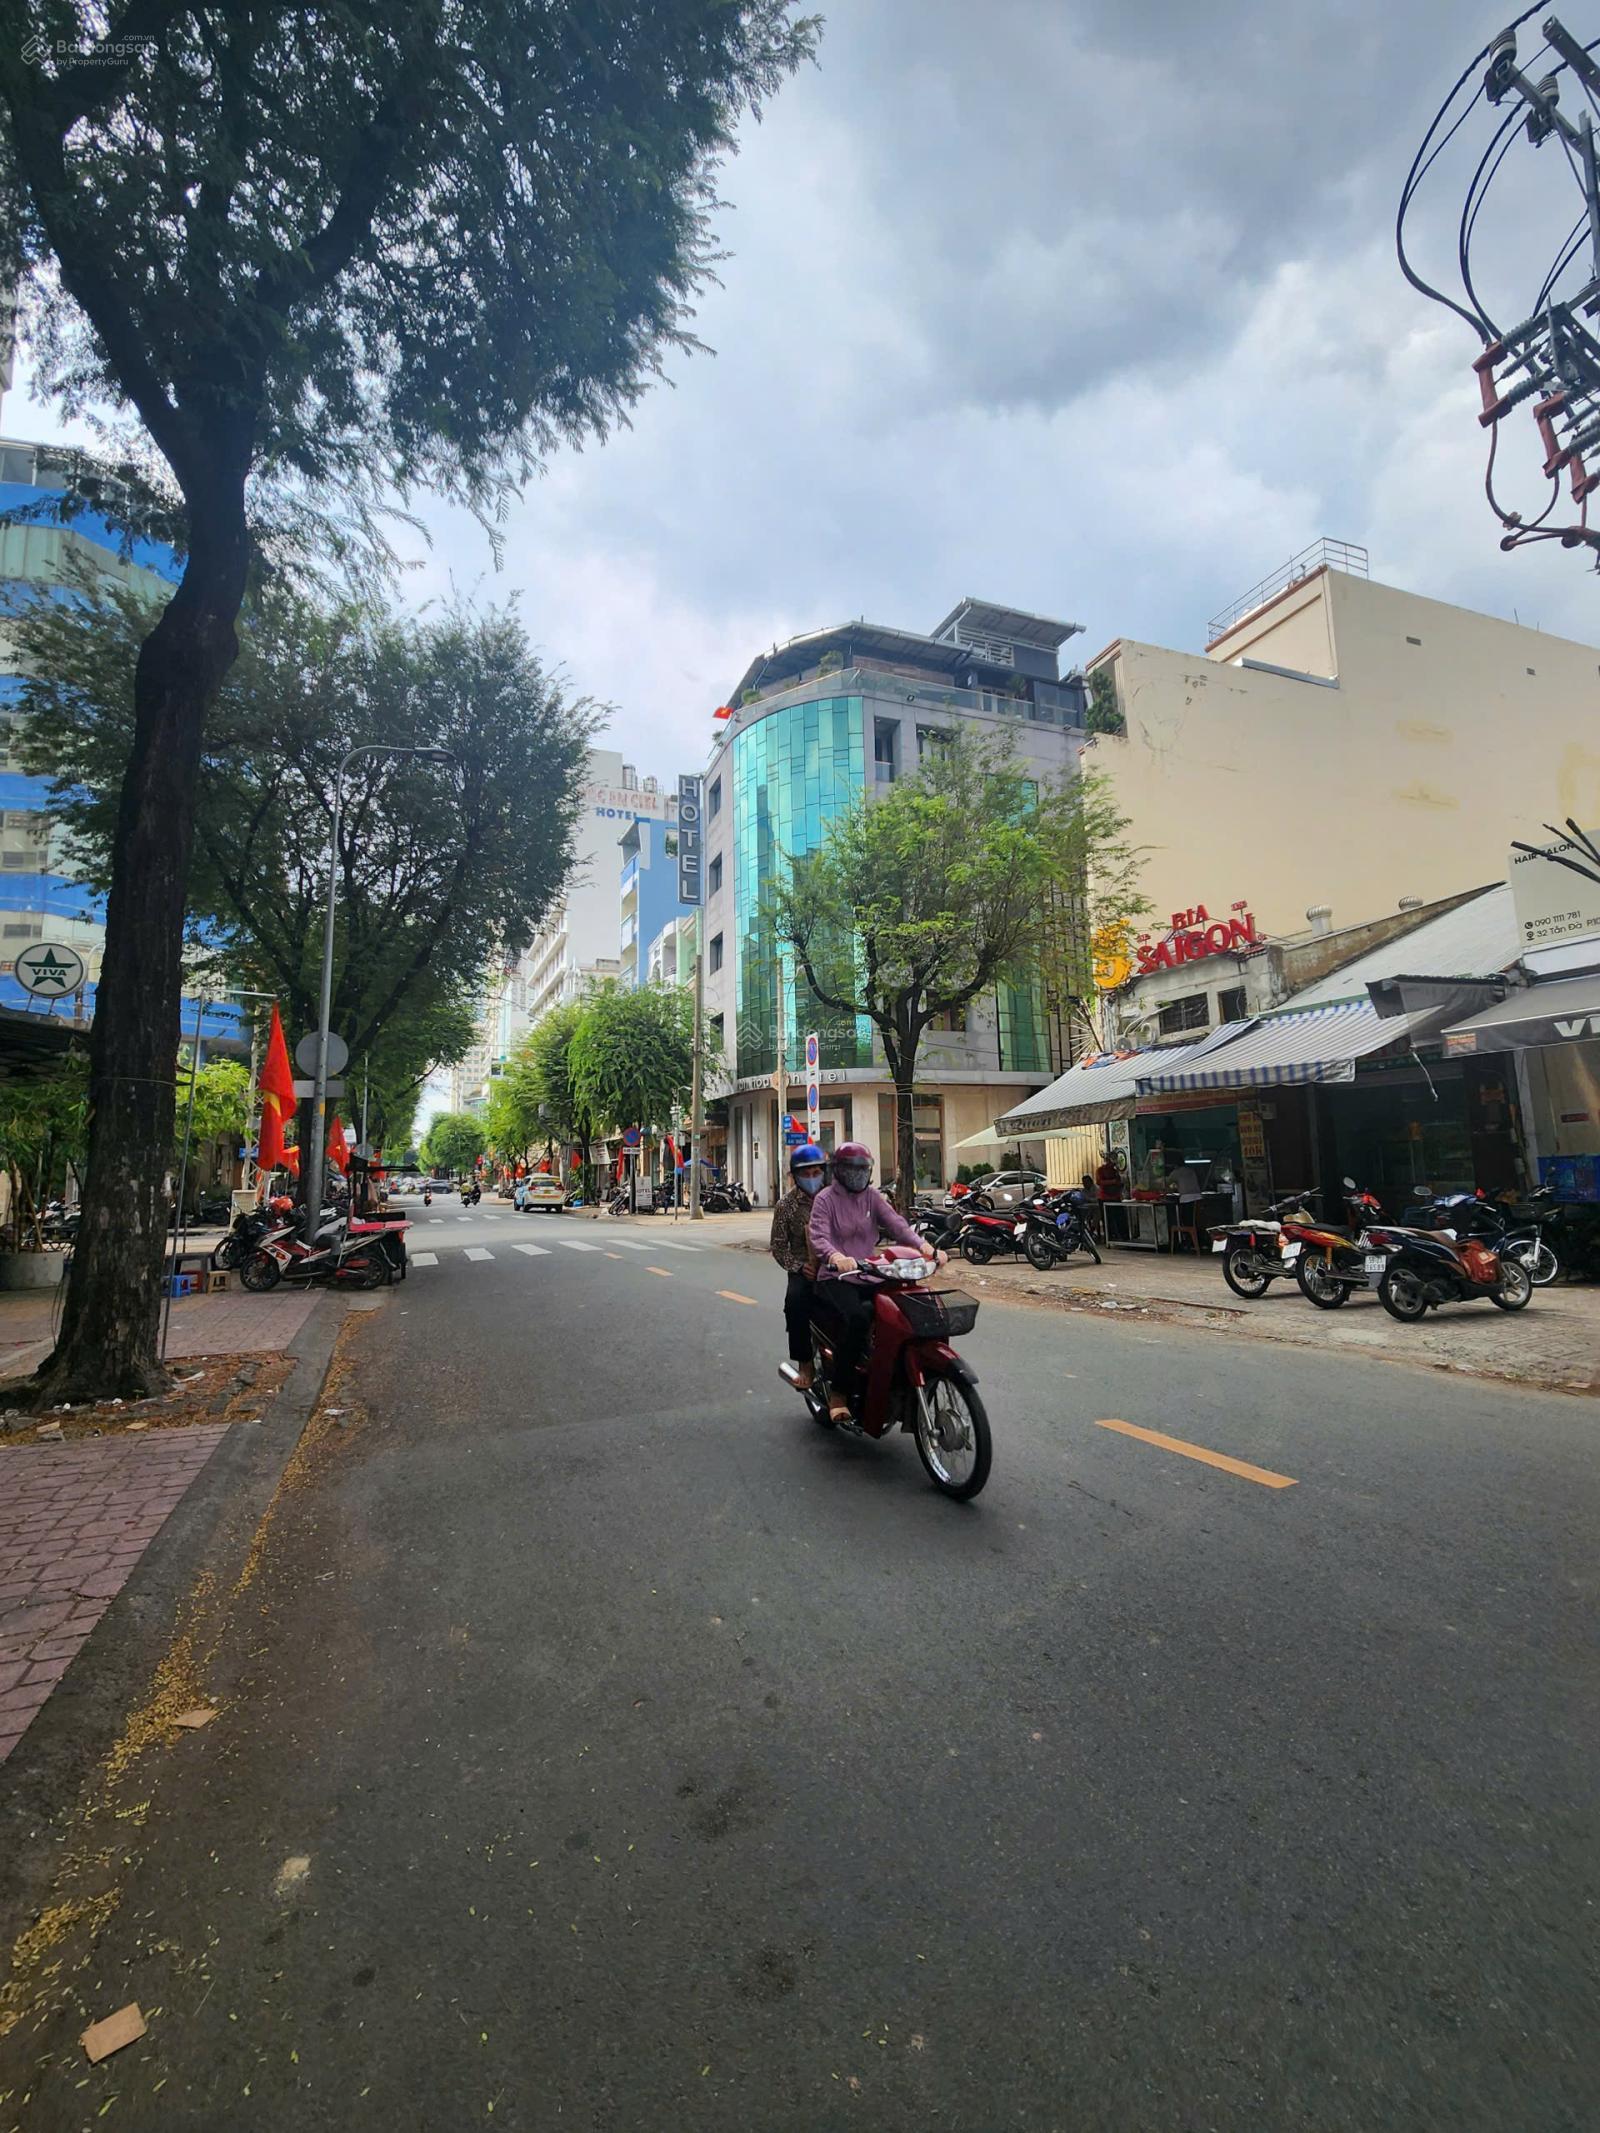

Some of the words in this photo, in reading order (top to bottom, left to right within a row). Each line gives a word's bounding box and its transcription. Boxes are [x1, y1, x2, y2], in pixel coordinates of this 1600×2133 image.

[681, 778, 699, 899] HOTEL
[1514, 852, 1537, 864] HAIR
[1541, 843, 1575, 857] ALON
[1171, 904, 1210, 930] BIA
[1534, 917, 1551, 927] 090
[1566, 910, 1581, 920] 781
[1536, 929, 1548, 937] 32
[1136, 913, 1256, 974] SAIGON
[31, 968, 67, 977] VIVA
[793, 1069, 846, 1084] htel
